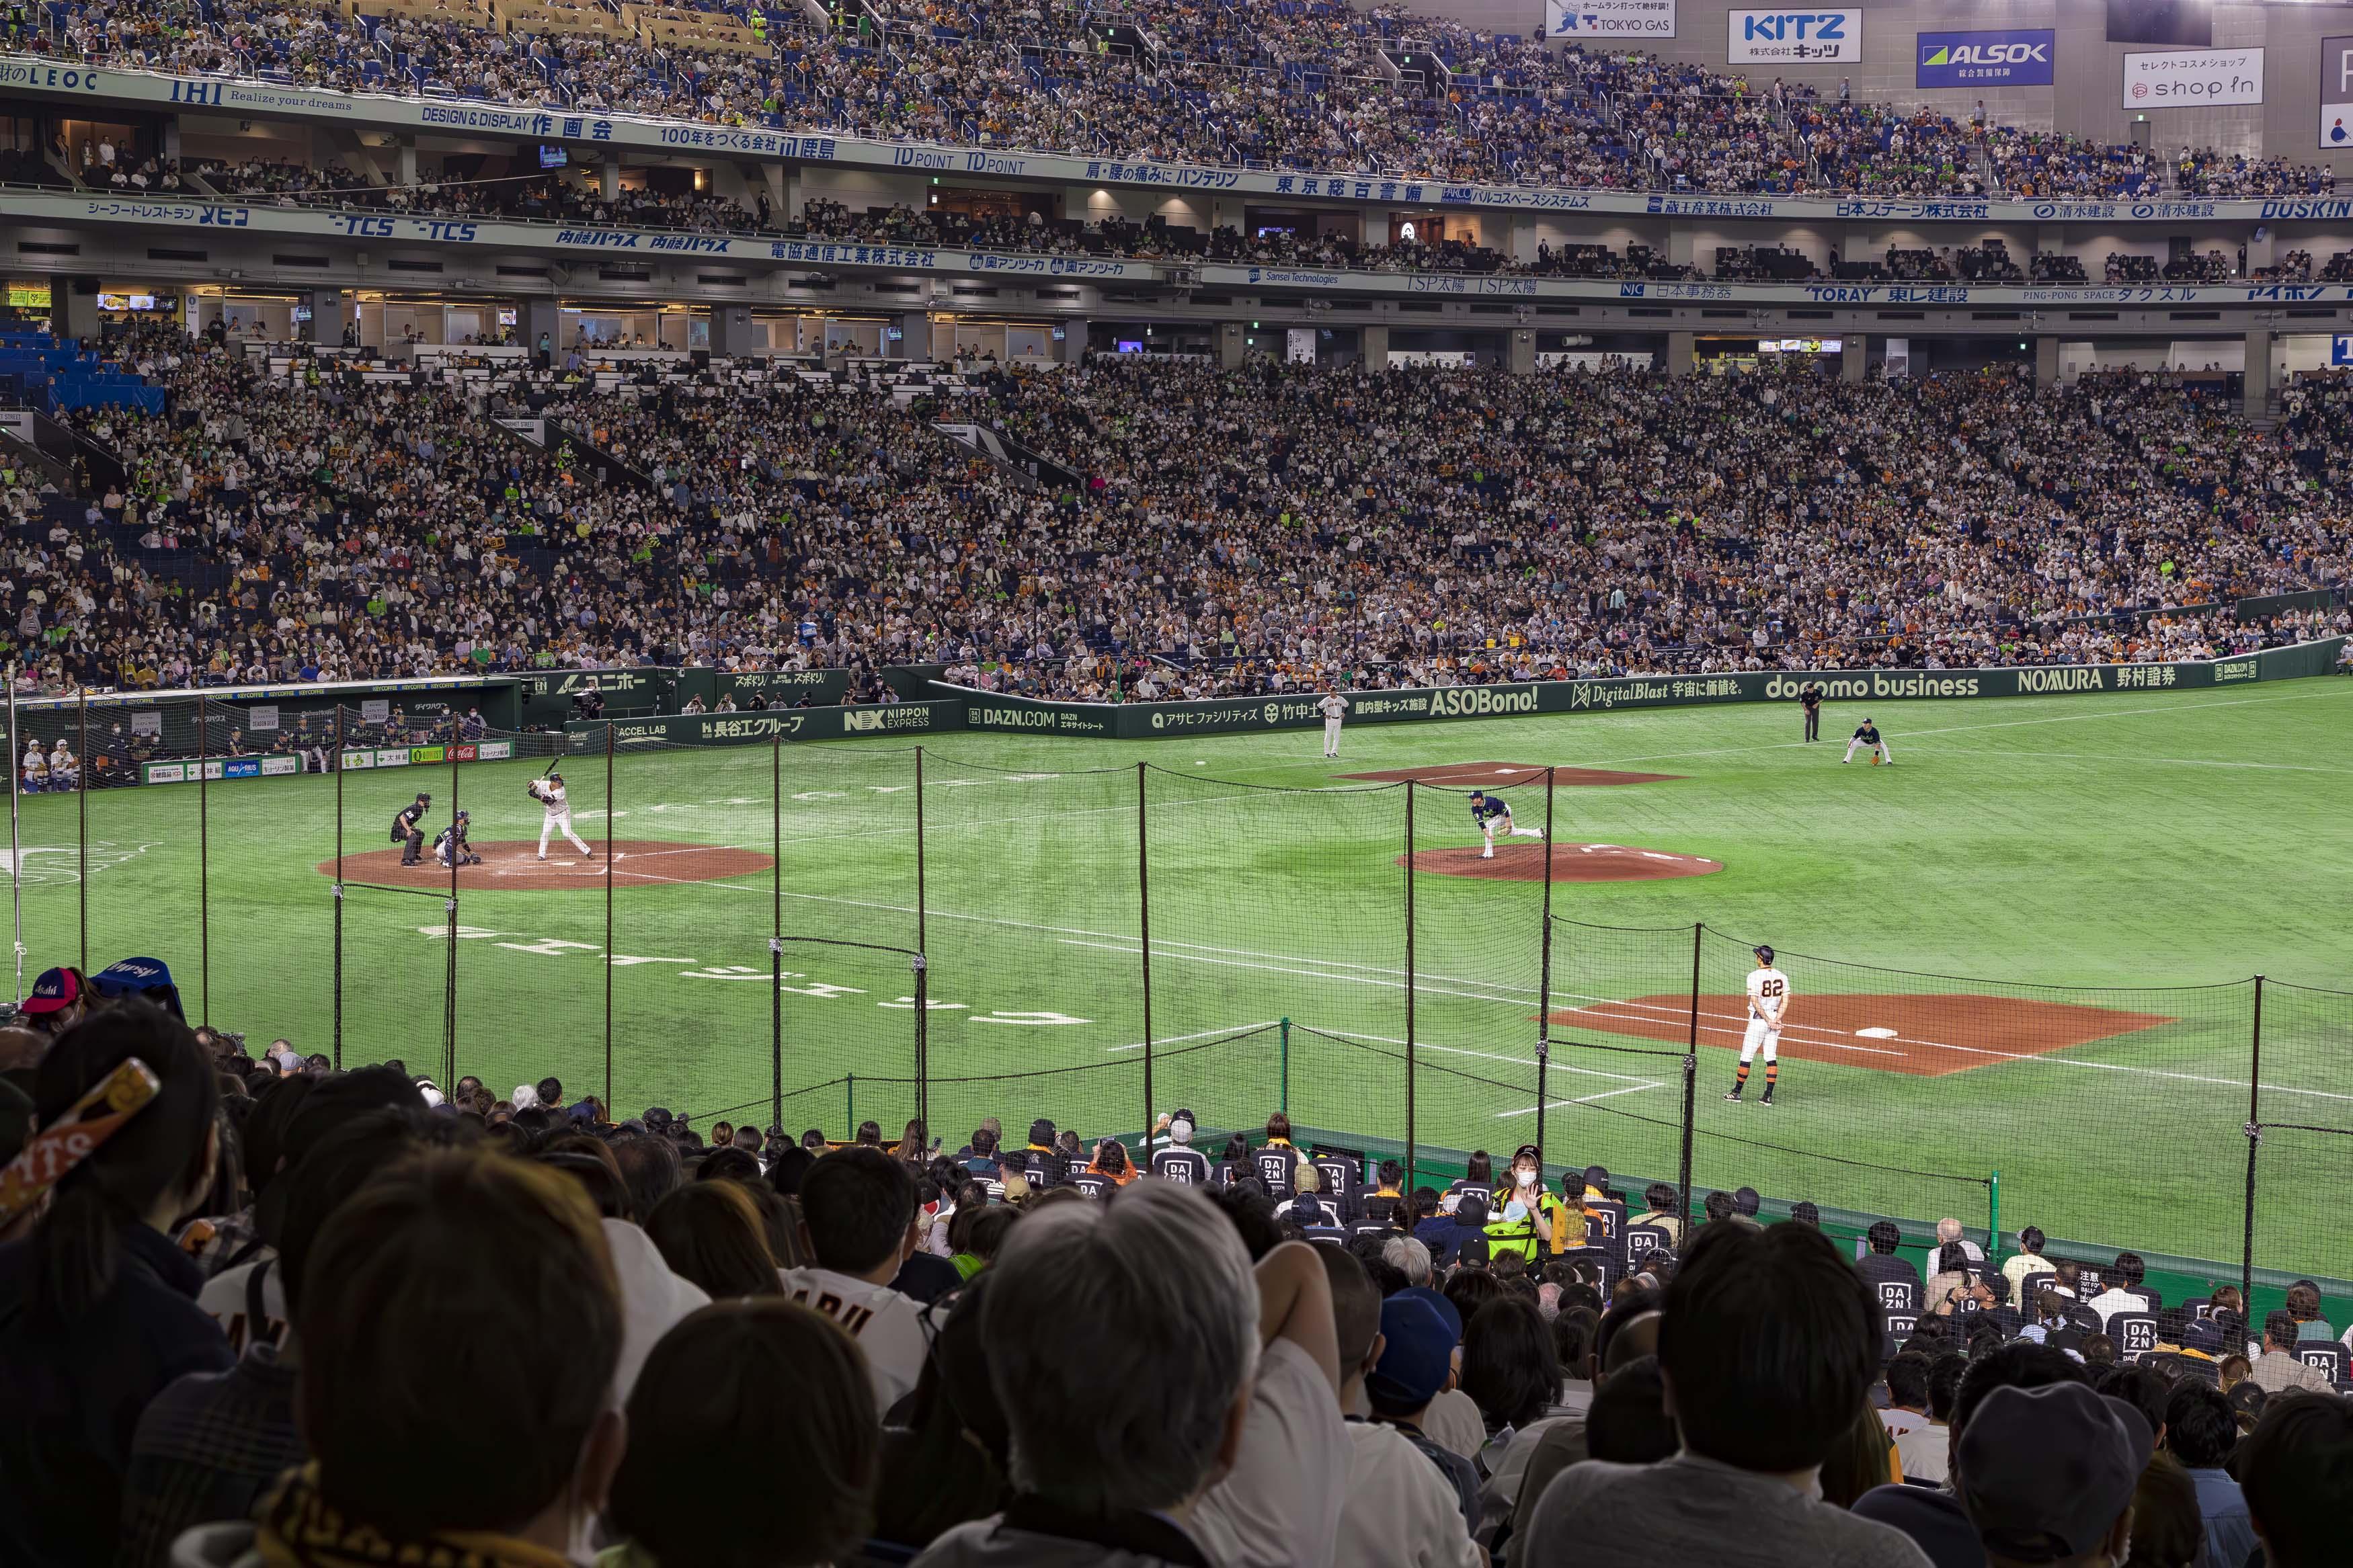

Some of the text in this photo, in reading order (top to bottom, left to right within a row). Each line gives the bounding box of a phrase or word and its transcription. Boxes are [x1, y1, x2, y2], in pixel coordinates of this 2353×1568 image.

[1601, 19, 1669, 30] TOKYO GAS
[1745, 15, 1845, 40] KITZ
[1948, 43, 2047, 65] ALSOK
[2141, 56, 2247, 70] セレクトコスメショップ
[30, 67, 97, 90] LEOC
[169, 80, 223, 106] IHI
[2155, 81, 2222, 99] shop
[231, 91, 352, 110] Realize your dreams
[422, 108, 529, 130] DESIGN & DISPLAY
[662, 128, 776, 151] 100年をつくる会社
[915, 154, 954, 168] POINT
[987, 159, 1025, 174] POINT
[1443, 188, 1472, 199] PARCO
[1472, 191, 1591, 208] パルコスペースシステムズ
[88, 203, 194, 219] シーフードレストラン
[1665, 200, 1773, 215] 蔵王産業株式会社
[1836, 204, 1989, 218] 日本ステージ株式会社
[2059, 205, 2115, 218] 清水建設
[2158, 204, 2215, 217] 清水建設
[555, 230, 640, 247] 内藤ハウス
[649, 237, 731, 252] 内藤ハウス
[771, 243, 935, 267] 電協通信工業株式会社
[984, 256, 1044, 270] 奥アンツーカ
[1065, 260, 1123, 274] 奥アンツーカ
[1267, 272, 1290, 281] Sansei
[1292, 272, 1338, 285] Technologies
[1623, 284, 1643, 294] NJC
[1888, 288, 1968, 302] 東レ建設
[2023, 291, 2077, 299] PING-PONG
[586, 673, 645, 691] ユニホー
[1874, 673, 1979, 696] business
[2018, 669, 2103, 692] NOMURA
[2117, 667, 2176, 688] 野村證券
[1592, 683, 1668, 707] DigitalBlast
[1672, 679, 1743, 697] 宇宙に価値を。
[1355, 686, 1538, 716] 屋内型キッズ施設 ASOBono!
[887, 707, 929, 718] NIPPON
[984, 709, 1055, 727] DAZN.COM
[1166, 708, 1258, 726] アサヒ ファシリティズ
[1282, 702, 1322, 720] 竹中土
[714, 716, 804, 738] 長谷工グループ
[887, 718, 929, 729] EXPRESS
[1061, 721, 1103, 731] エキサイトシート
[619, 725, 666, 737] ACCEL LAB
[405, 811, 415, 819] 28
[1761, 979, 1784, 997] 82
[1170, 1164, 1186, 1173] DA
[1265, 1160, 1280, 1169] DA
[1265, 1170, 1280, 1179] ZN
[1080, 1185, 1096, 1195] DA
[1635, 1237, 1652, 1247] DA
[2080, 1270, 2099, 1282] 注意
[1886, 1288, 1904, 1298] DA
[1886, 1299, 1903, 1309] ZN
[2130, 1325, 2150, 1335] DA
[2130, 1337, 2149, 1348] ZN
[2309, 1356, 2329, 1368] DA
